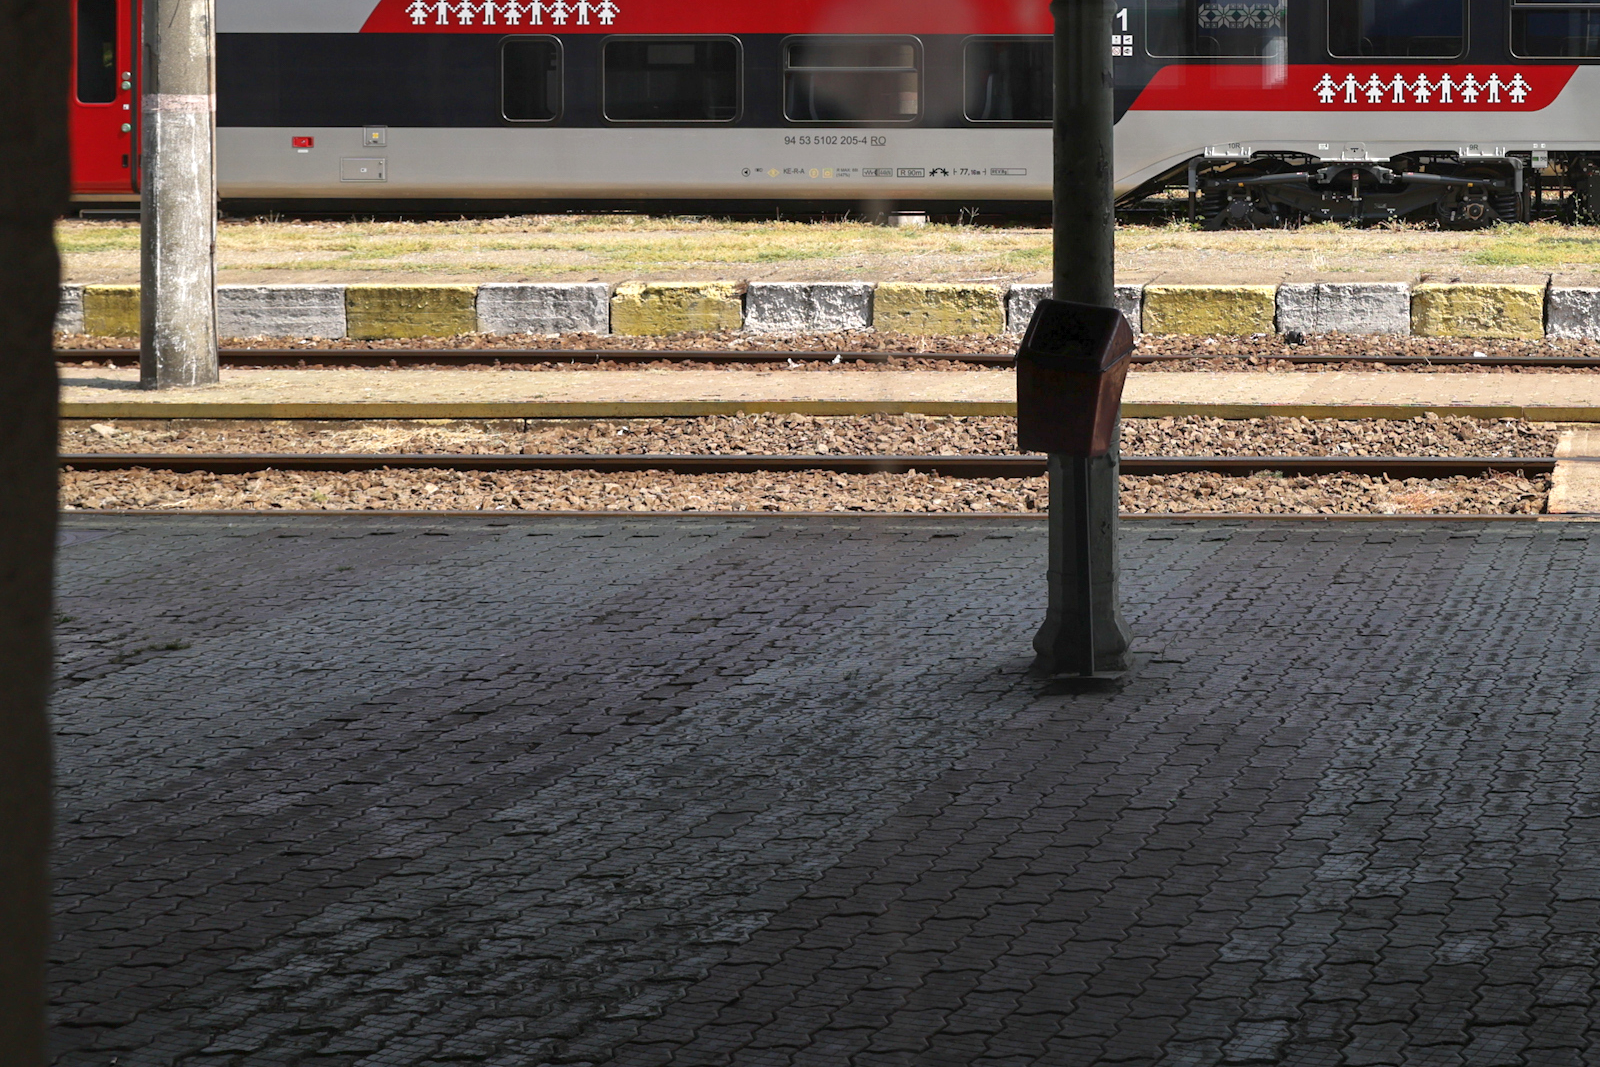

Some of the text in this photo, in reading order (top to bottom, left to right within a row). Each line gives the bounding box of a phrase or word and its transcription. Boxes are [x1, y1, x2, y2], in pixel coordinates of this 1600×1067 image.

[1116, 7, 1128, 32] 1
[784, 136, 887, 146] 94 53 5102 205-4 RO
